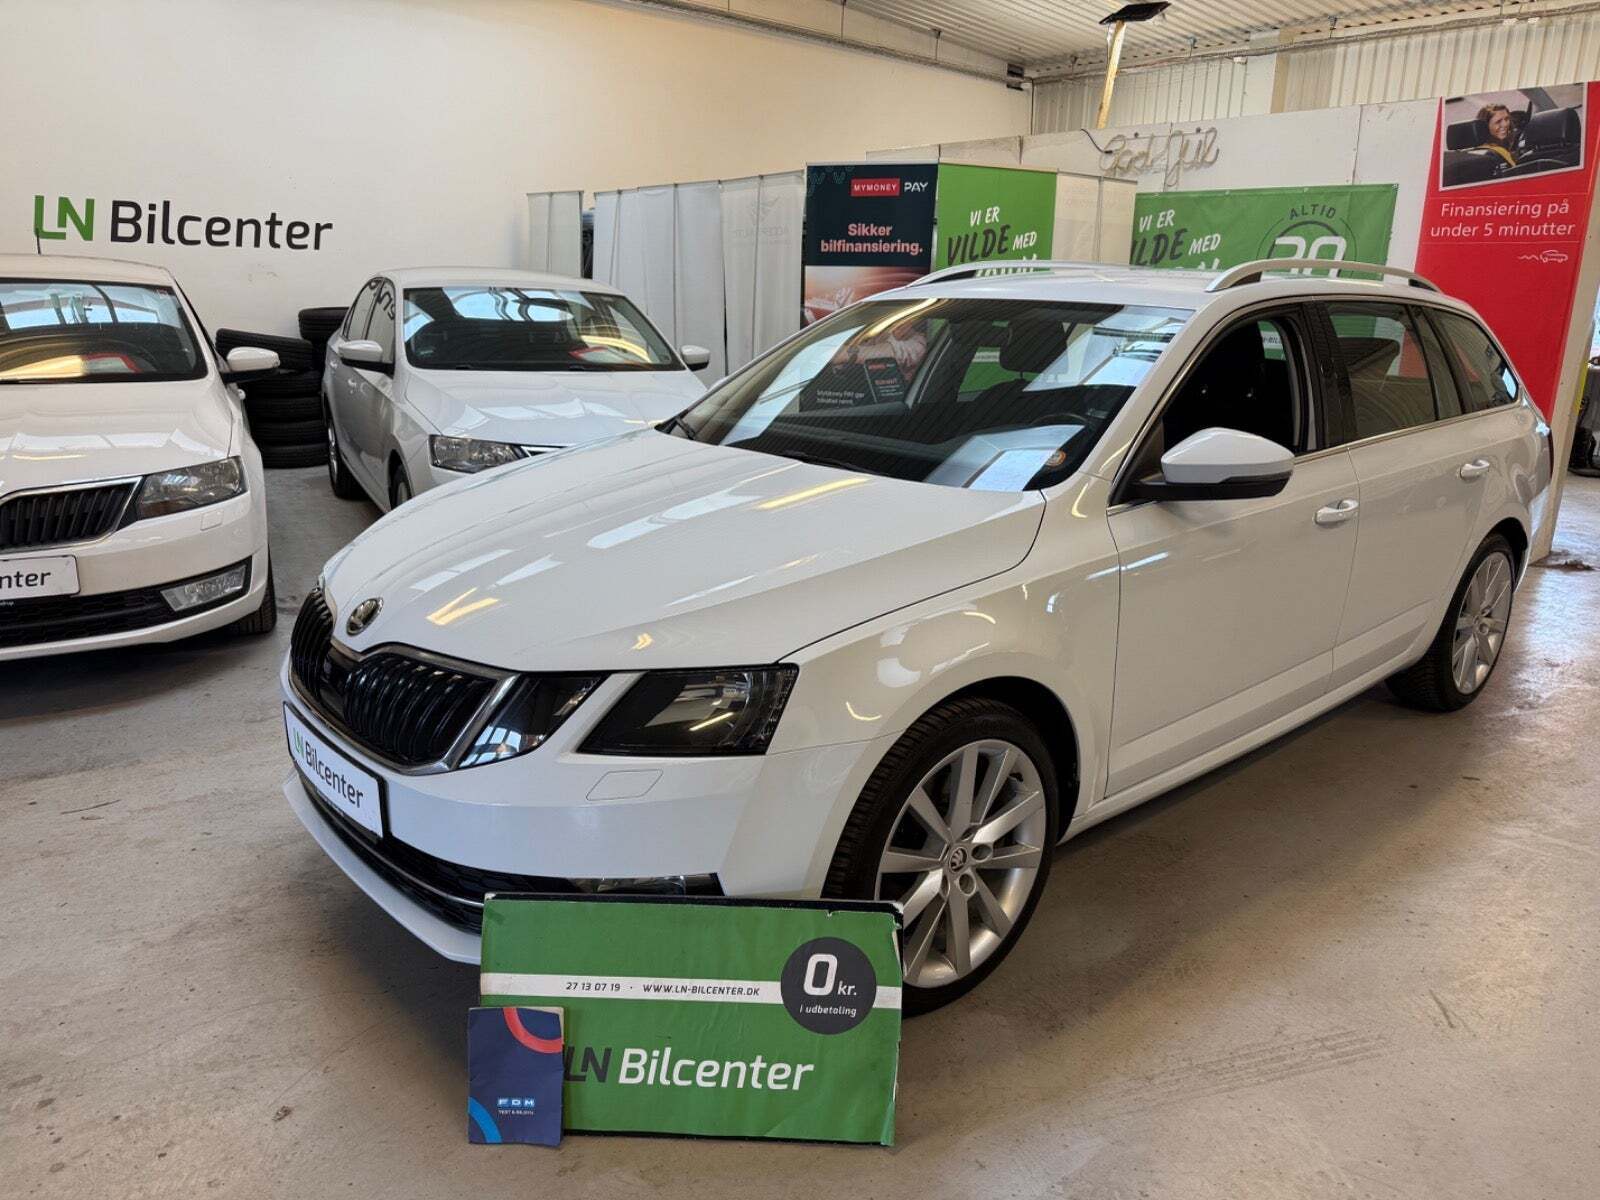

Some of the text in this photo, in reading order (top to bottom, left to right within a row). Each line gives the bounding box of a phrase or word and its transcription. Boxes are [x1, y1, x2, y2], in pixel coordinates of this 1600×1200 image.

[853, 182, 929, 193] MYMONEY PAY
[970, 206, 1001, 228] VI ER
[1289, 203, 1337, 220] ALTID
[1441, 198, 1570, 219] Finansiering på
[34, 194, 333, 251] LN Bilcenter
[848, 223, 894, 237] Sikker
[1139, 208, 1176, 233] VI ER
[1430, 222, 1576, 237] under 5 minutter
[820, 239, 924, 256] bilfinansiering.
[947, 224, 1012, 266] VILDE
[1012, 231, 1038, 251] MED
[1188, 233, 1222, 256] MED
[293, 727, 365, 809] LN Bilcenter
[803, 952, 858, 996] 0 kr.
[565, 982, 760, 997] 27 13 07 19 WWW.LN-BILCENTER.DK
[805, 1004, 858, 1018] udbetaling
[563, 1046, 815, 1092] LN Bilcenter
